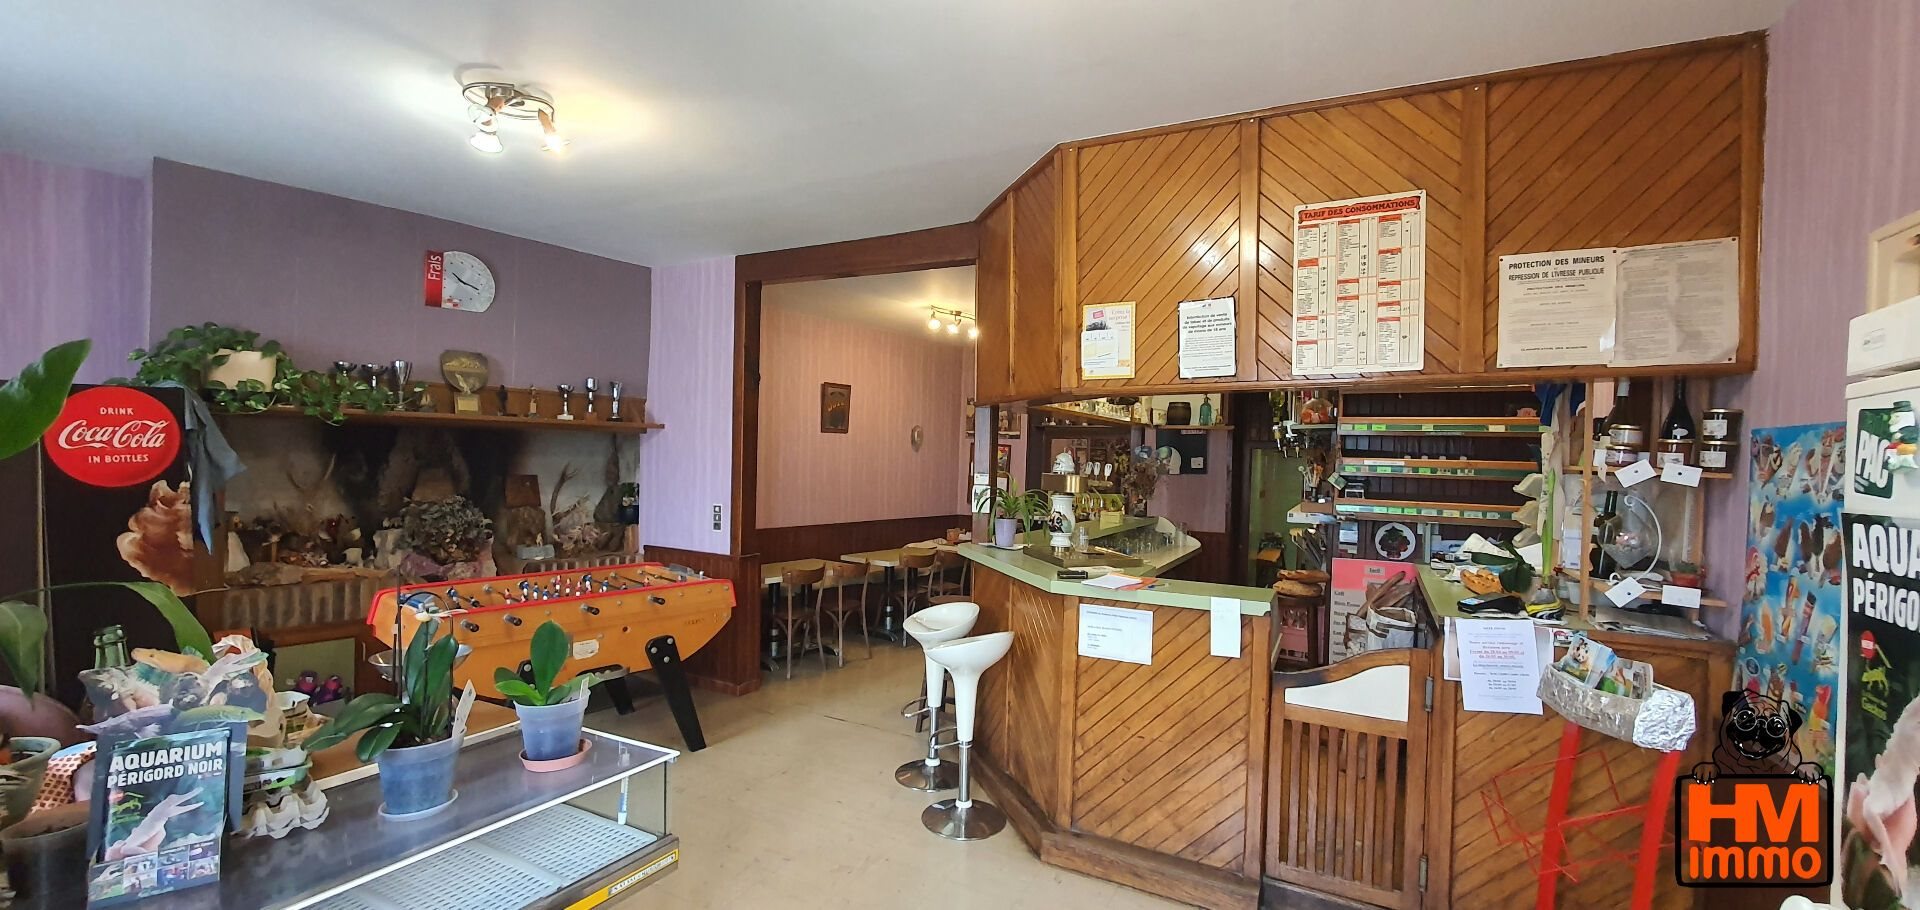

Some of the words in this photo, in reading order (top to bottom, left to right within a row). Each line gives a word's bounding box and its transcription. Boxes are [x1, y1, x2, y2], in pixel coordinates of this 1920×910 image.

[1304, 211, 1326, 219] TARIF
[1345, 199, 1415, 214] CONSOMMATIONS
[1508, 259, 1551, 270] PROTECTION
[1555, 258, 1569, 266] DES
[1572, 255, 1605, 265] MINEURS
[1578, 267, 1605, 276] PUBLIQUE
[100, 407, 134, 415] DRINK
[58, 419, 170, 449] Coca-Cola
[88, 455, 101, 463] IN
[104, 454, 149, 463] BOTTLES
[1852, 572, 1920, 633] PÉRIGO
[109, 740, 223, 773] AQUARIUM
[106, 764, 184, 789] PÉRIGORD
[187, 758, 223, 775] NOIR
